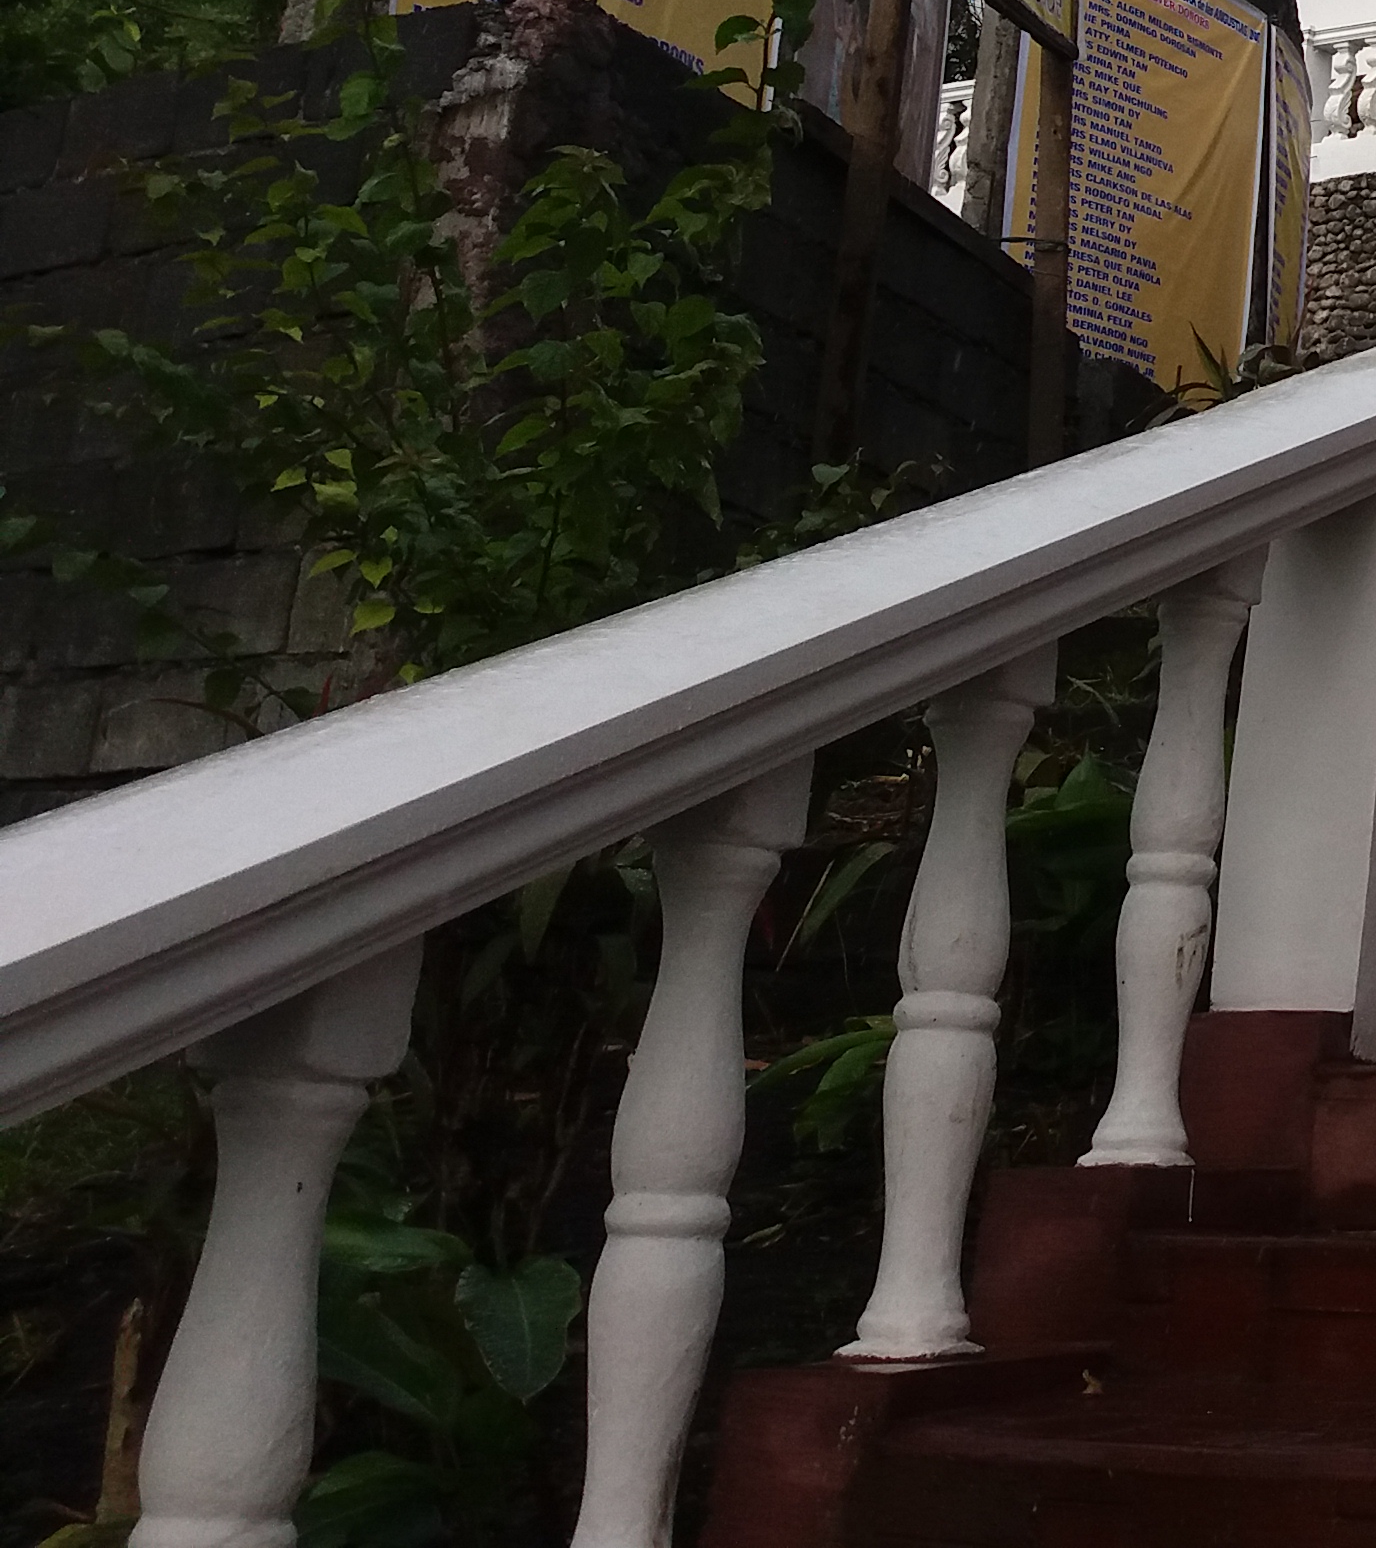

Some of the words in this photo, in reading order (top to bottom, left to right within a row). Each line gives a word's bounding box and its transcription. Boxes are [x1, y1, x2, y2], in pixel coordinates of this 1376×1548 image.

[1088, 1, 1110, 17] MRS.
[1116, 13, 1157, 38] DOMINGO
[1100, 19, 1131, 39] PRIMA
[1117, 1, 1146, 20] ALGER
[1148, 15, 1184, 38] MILDRED
[1085, 26, 1111, 43] ATTY.
[1116, 39, 1146, 59] ELMER
[1097, 44, 1128, 64] EDWIN
[1131, 59, 1148, 72] TAN
[1095, 70, 1119, 86] MIKE
[1123, 82, 1142, 95] QUE
[1117, 65, 1136, 79] TAN
[1089, 81, 1110, 94] RAY
[1092, 94, 1125, 114] SIMON
[1128, 108, 1141, 120] DY
[1090, 121, 1130, 142] MANUEL
[1113, 116, 1133, 130] TAN
[1089, 134, 1117, 150] ELMO
[1087, 159, 1113, 176] MIKE
[1089, 147, 1131, 168] WILLIAM
[1085, 186, 1130, 207] RODOLFO
[1086, 173, 1138, 197] CLARKSON
[1141, 192, 1153, 203] DE
[1156, 197, 1172, 211] LAS
[1081, 197, 1113, 215] PETER
[1117, 210, 1135, 223] TAN
[1083, 213, 1115, 229] JERRY
[1119, 222, 1132, 235] DY
[1081, 225, 1121, 244] NELSON
[1124, 236, 1137, 250] DY
[1103, 260, 1123, 272] QUE
[1131, 254, 1157, 270] PAVIA
[1077, 265, 1109, 281] PETER
[1112, 275, 1140, 291] OLIVA
[1076, 279, 1113, 296] DANIEL
[1116, 290, 1133, 302] LEE
[1105, 301, 1152, 322] GONZALES
[1107, 314, 1133, 329] FELIX
[1072, 319, 1127, 341] BERNARDO
[1129, 335, 1148, 348] NGO
